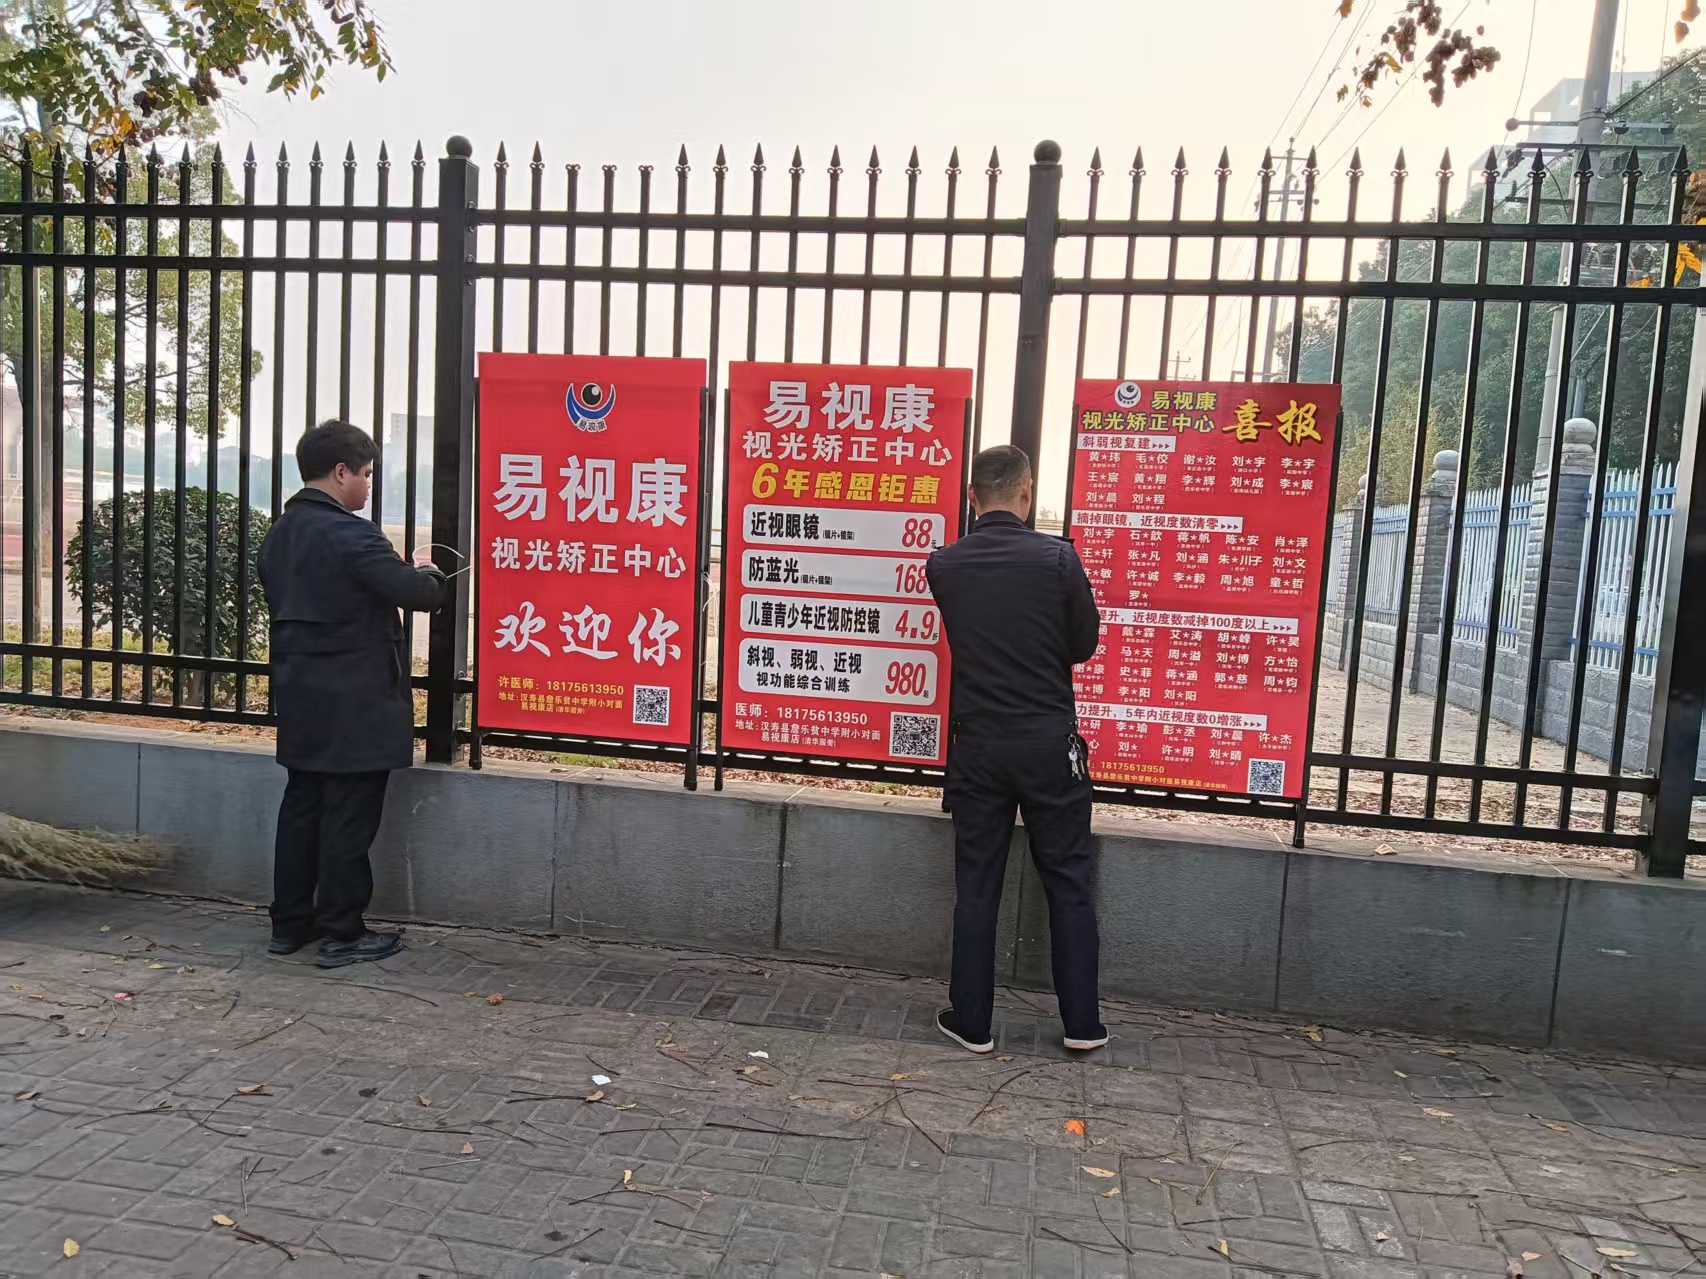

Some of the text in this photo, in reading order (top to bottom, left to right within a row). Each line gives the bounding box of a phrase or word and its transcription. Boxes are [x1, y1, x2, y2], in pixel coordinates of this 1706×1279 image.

[763, 381, 935, 433] 易视康
[1151, 390, 1217, 411] 易视康
[1082, 411, 1215, 433] 视光矫正中心
[1222, 398, 1322, 446] 喜报
[742, 431, 952, 467] 视光矫正中心
[1082, 435, 1151, 449] 斜弱视复建
[493, 454, 688, 527] 易视康
[752, 462, 941, 504] 6年感恩钜惠
[1076, 512, 1219, 530] 摘掉眼镜，近视度数清零
[491, 536, 686, 579] 视光矫正中心
[748, 600, 880, 635] 儿童青少年近视防控镜
[493, 601, 682, 667] 欢迎你
[747, 645, 862, 674] 斜视、弱视、近视
[546, 680, 624, 695] 18175613950
[756, 671, 851, 693] 视功能综合训练
[777, 707, 868, 725] 18175613950
[1101, 761, 1165, 774] 18175613950
